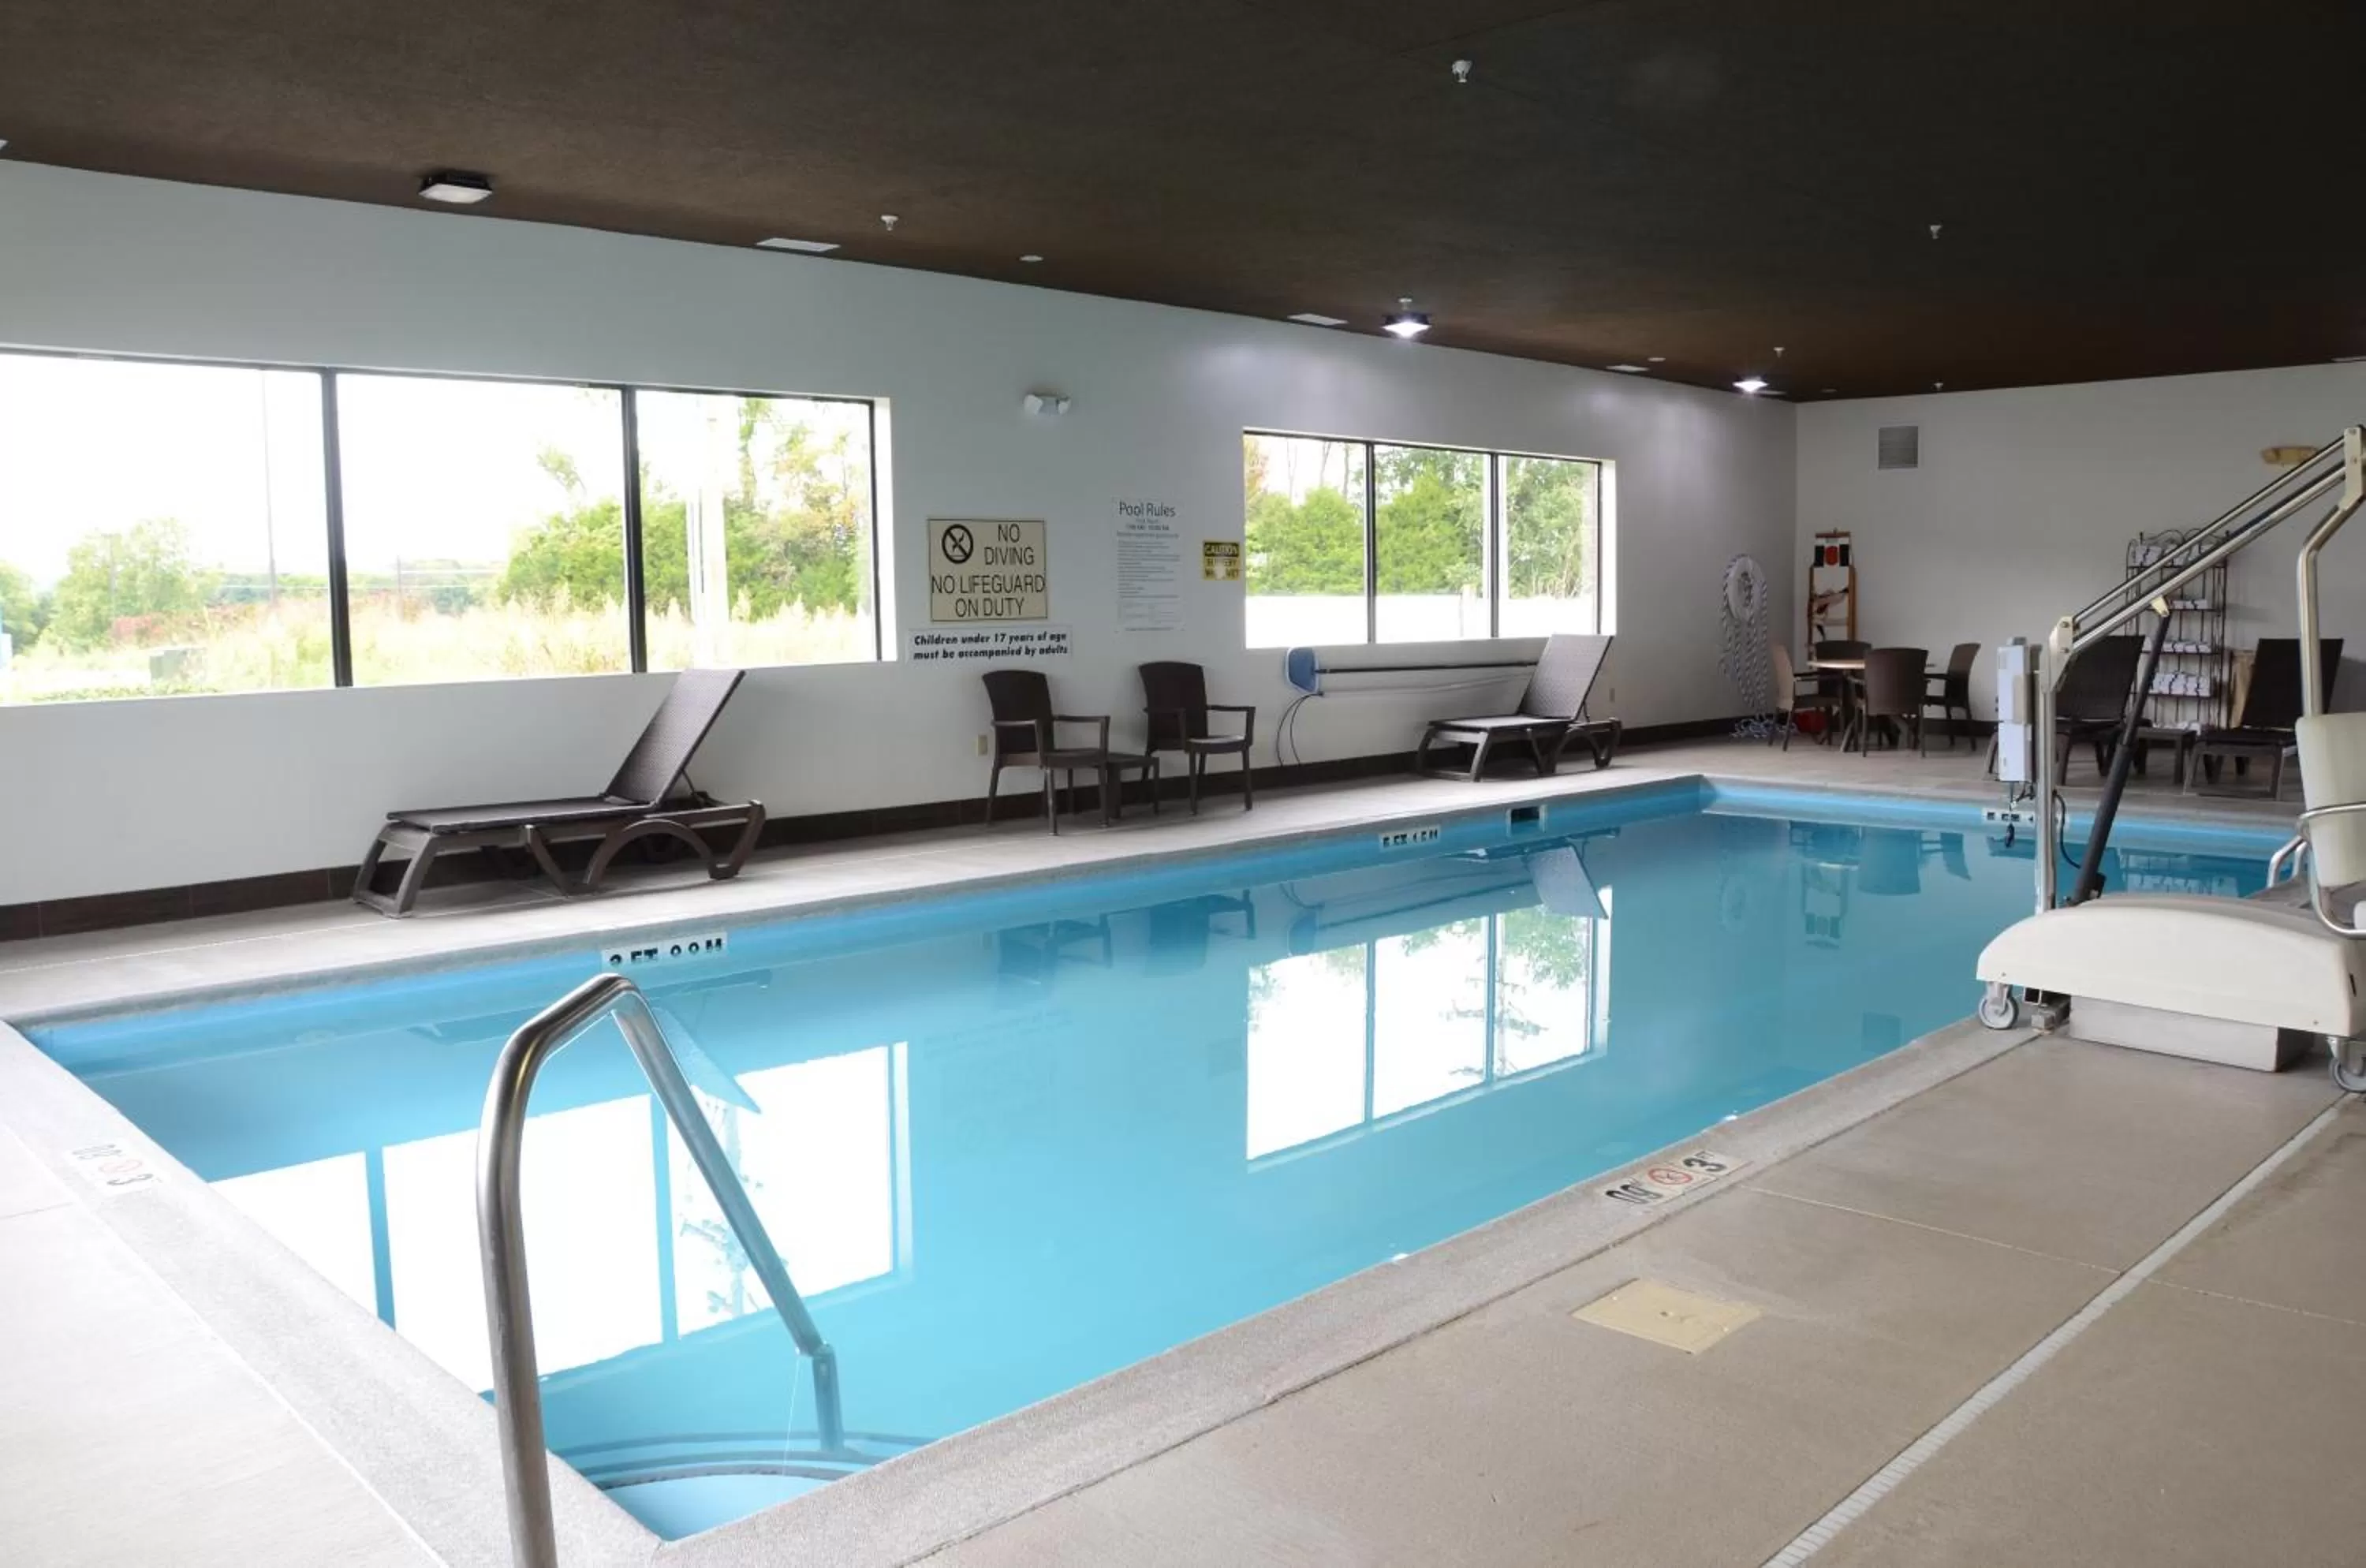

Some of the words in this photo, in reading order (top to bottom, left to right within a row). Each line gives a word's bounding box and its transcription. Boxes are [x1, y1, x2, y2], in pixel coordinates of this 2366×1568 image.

[1118, 501, 1144, 517] Pool
[1146, 501, 1176, 517] Rules
[998, 523, 1021, 543] NO
[983, 547, 1035, 566] DIVING
[931, 575, 955, 594] NO
[960, 574, 1046, 594] LIFEGUARD
[955, 598, 979, 618] ON
[983, 596, 1024, 617] DUTY
[914, 634, 958, 646] Children
[961, 633, 991, 644] under
[994, 633, 1006, 643] 17
[1009, 633, 1034, 644] years
[1037, 632, 1047, 642] of
[1050, 633, 1067, 643] age
[913, 650, 939, 660] must
[942, 648, 954, 659] be
[958, 646, 1023, 659] accompanied
[1025, 645, 1037, 656] by
[1039, 644, 1068, 655] adults
